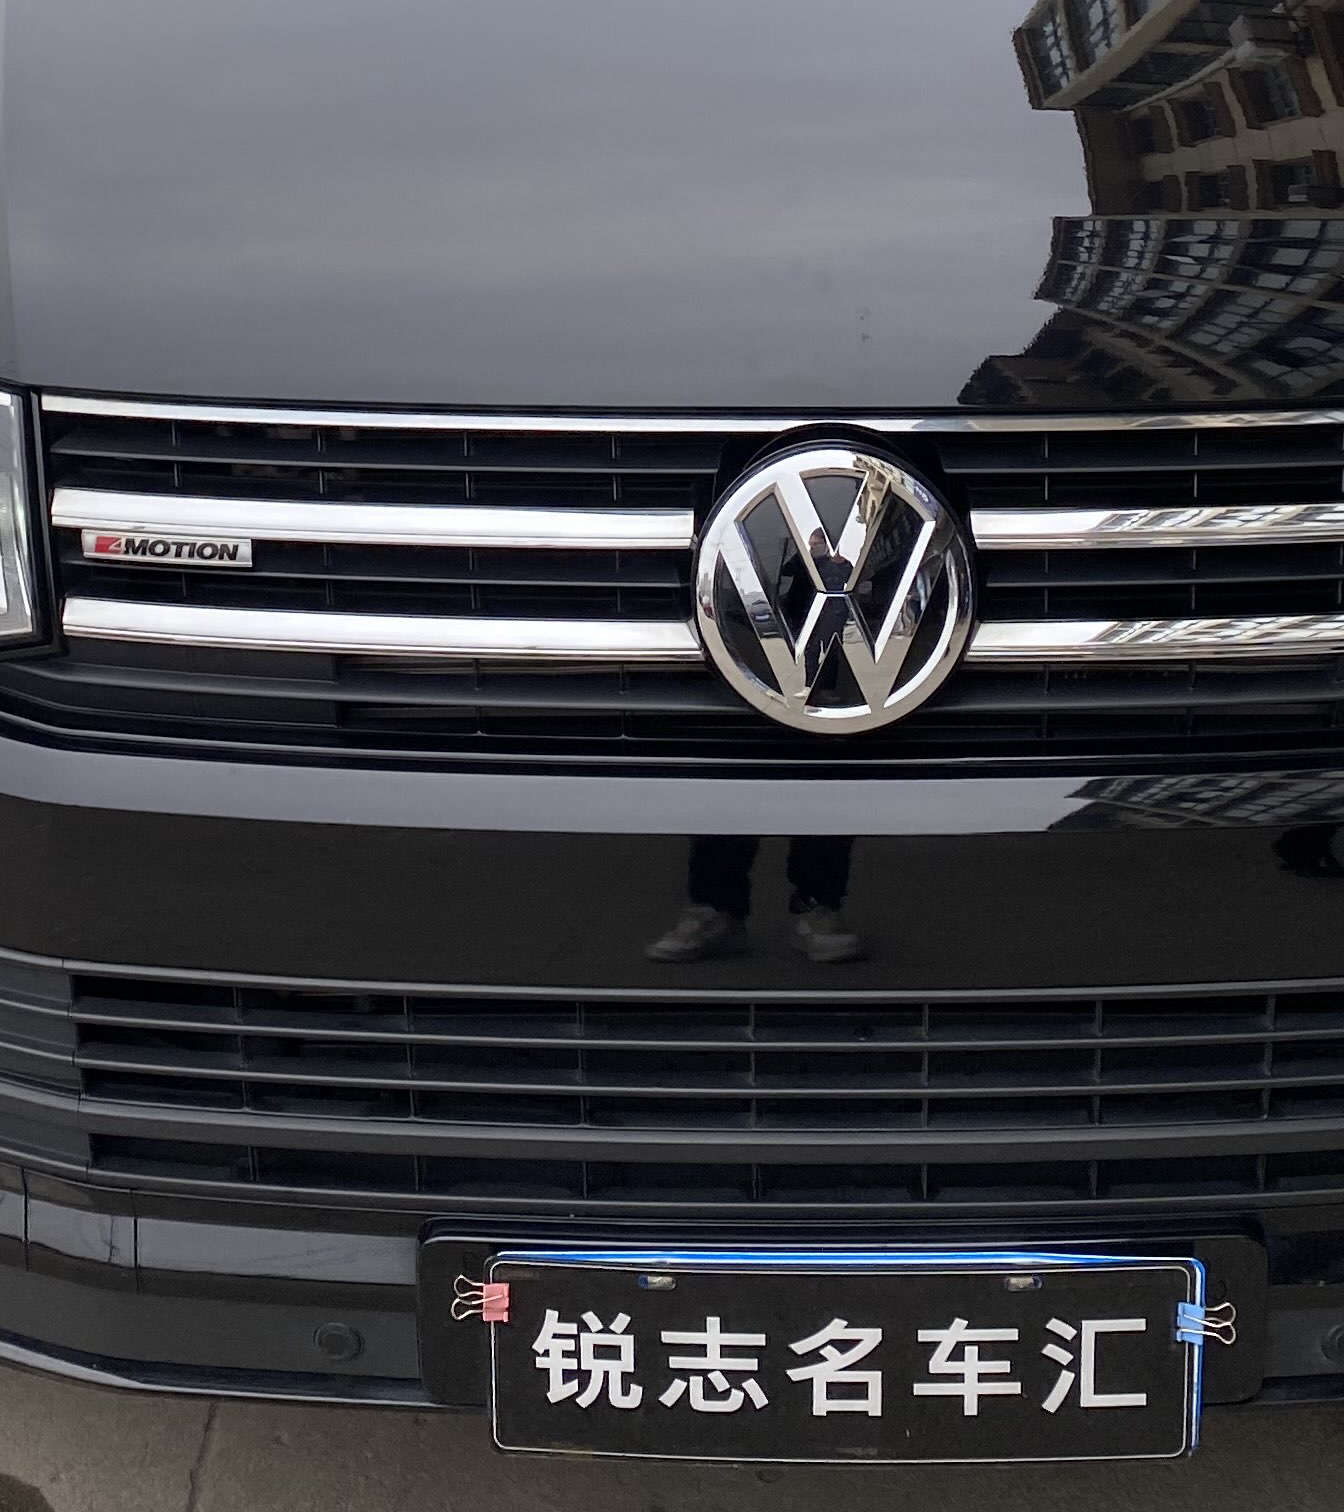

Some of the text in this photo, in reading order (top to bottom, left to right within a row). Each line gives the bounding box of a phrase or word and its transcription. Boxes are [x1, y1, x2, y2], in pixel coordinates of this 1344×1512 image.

[532, 1308, 1148, 1417] 锐志名车汇
